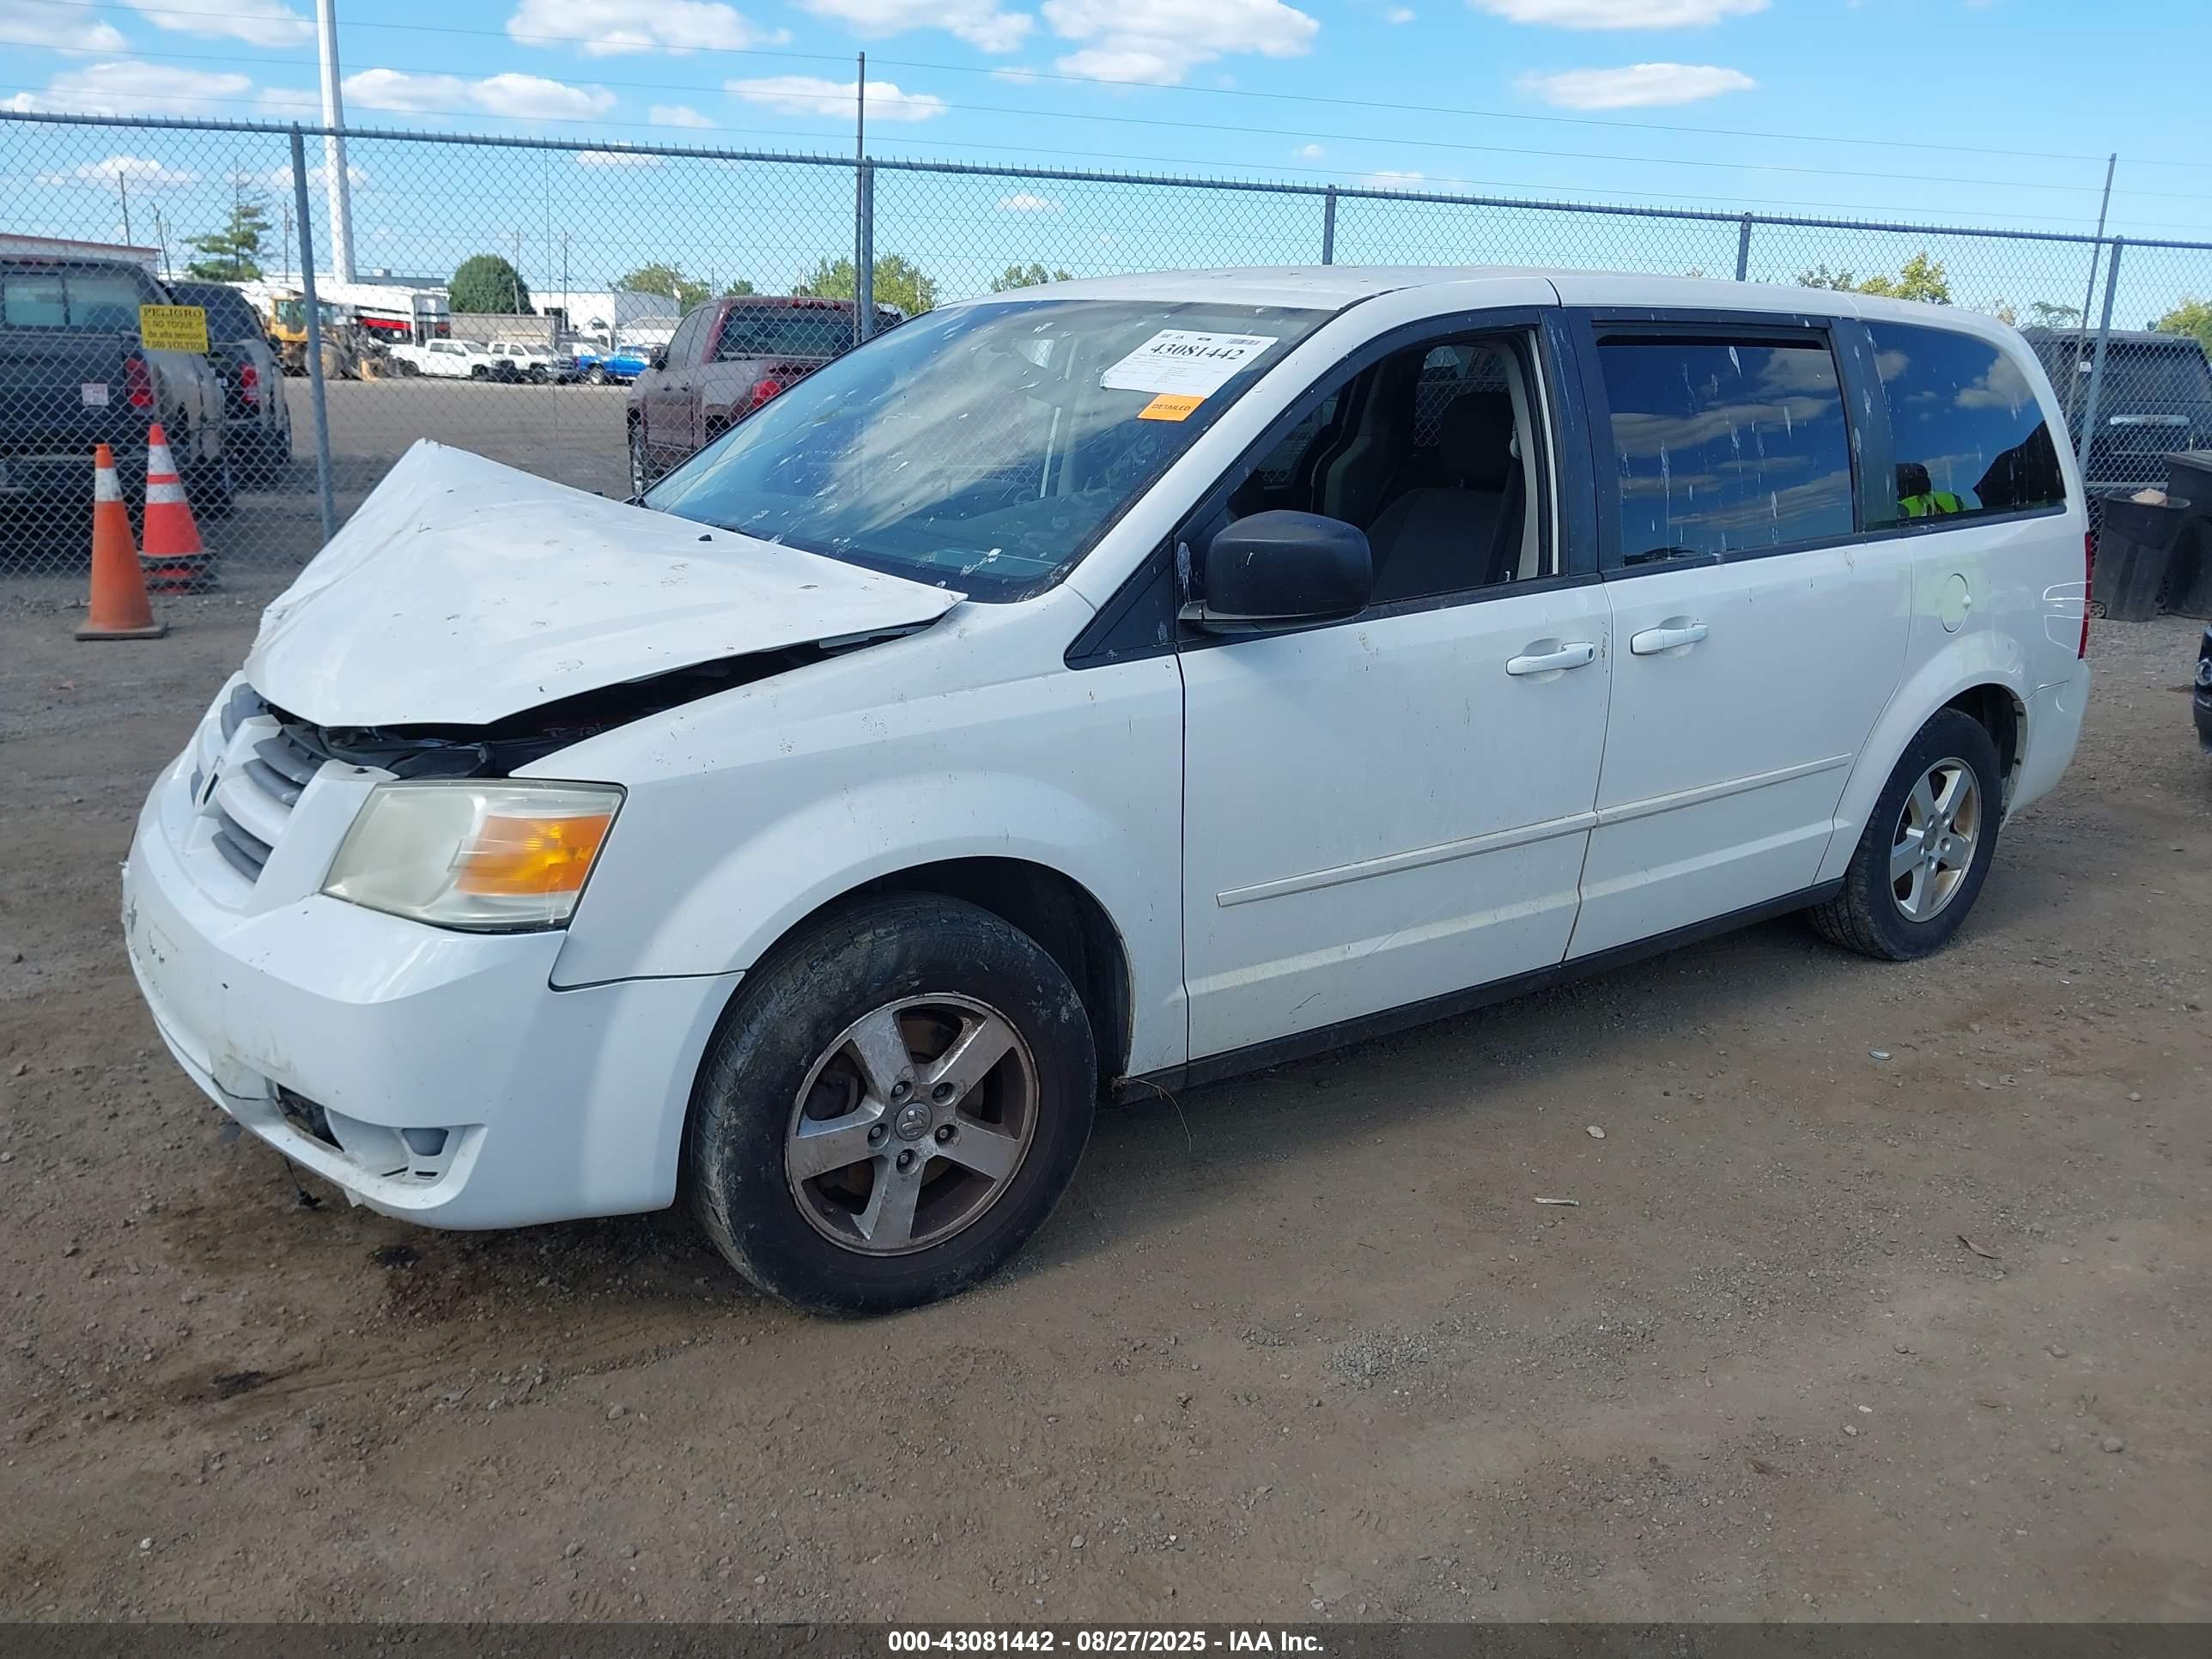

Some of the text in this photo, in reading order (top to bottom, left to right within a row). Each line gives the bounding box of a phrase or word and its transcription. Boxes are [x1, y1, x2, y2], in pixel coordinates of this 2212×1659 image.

[143, 308, 203, 318] PELIGRO
[152, 319, 194, 330] NO TOQUE
[1151, 343, 1245, 360] 43081442
